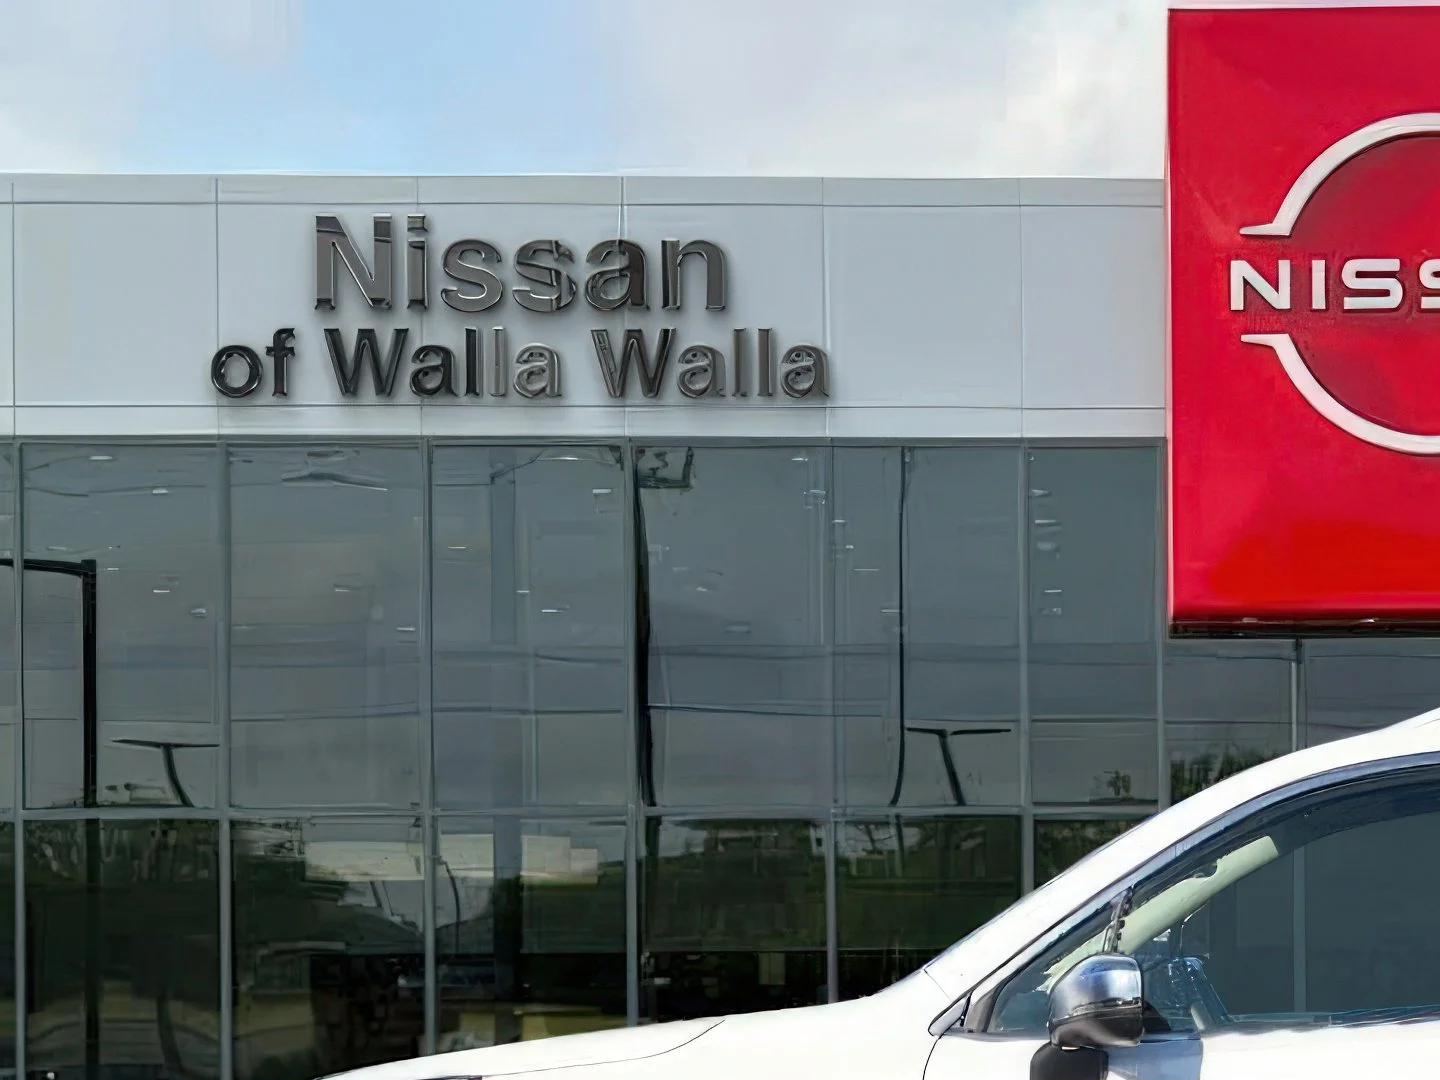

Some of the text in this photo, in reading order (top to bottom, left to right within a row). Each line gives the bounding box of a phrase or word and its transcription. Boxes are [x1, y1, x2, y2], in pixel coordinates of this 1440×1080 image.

[313, 210, 730, 312] Nissan
[209, 324, 831, 398] of Walla Walla
